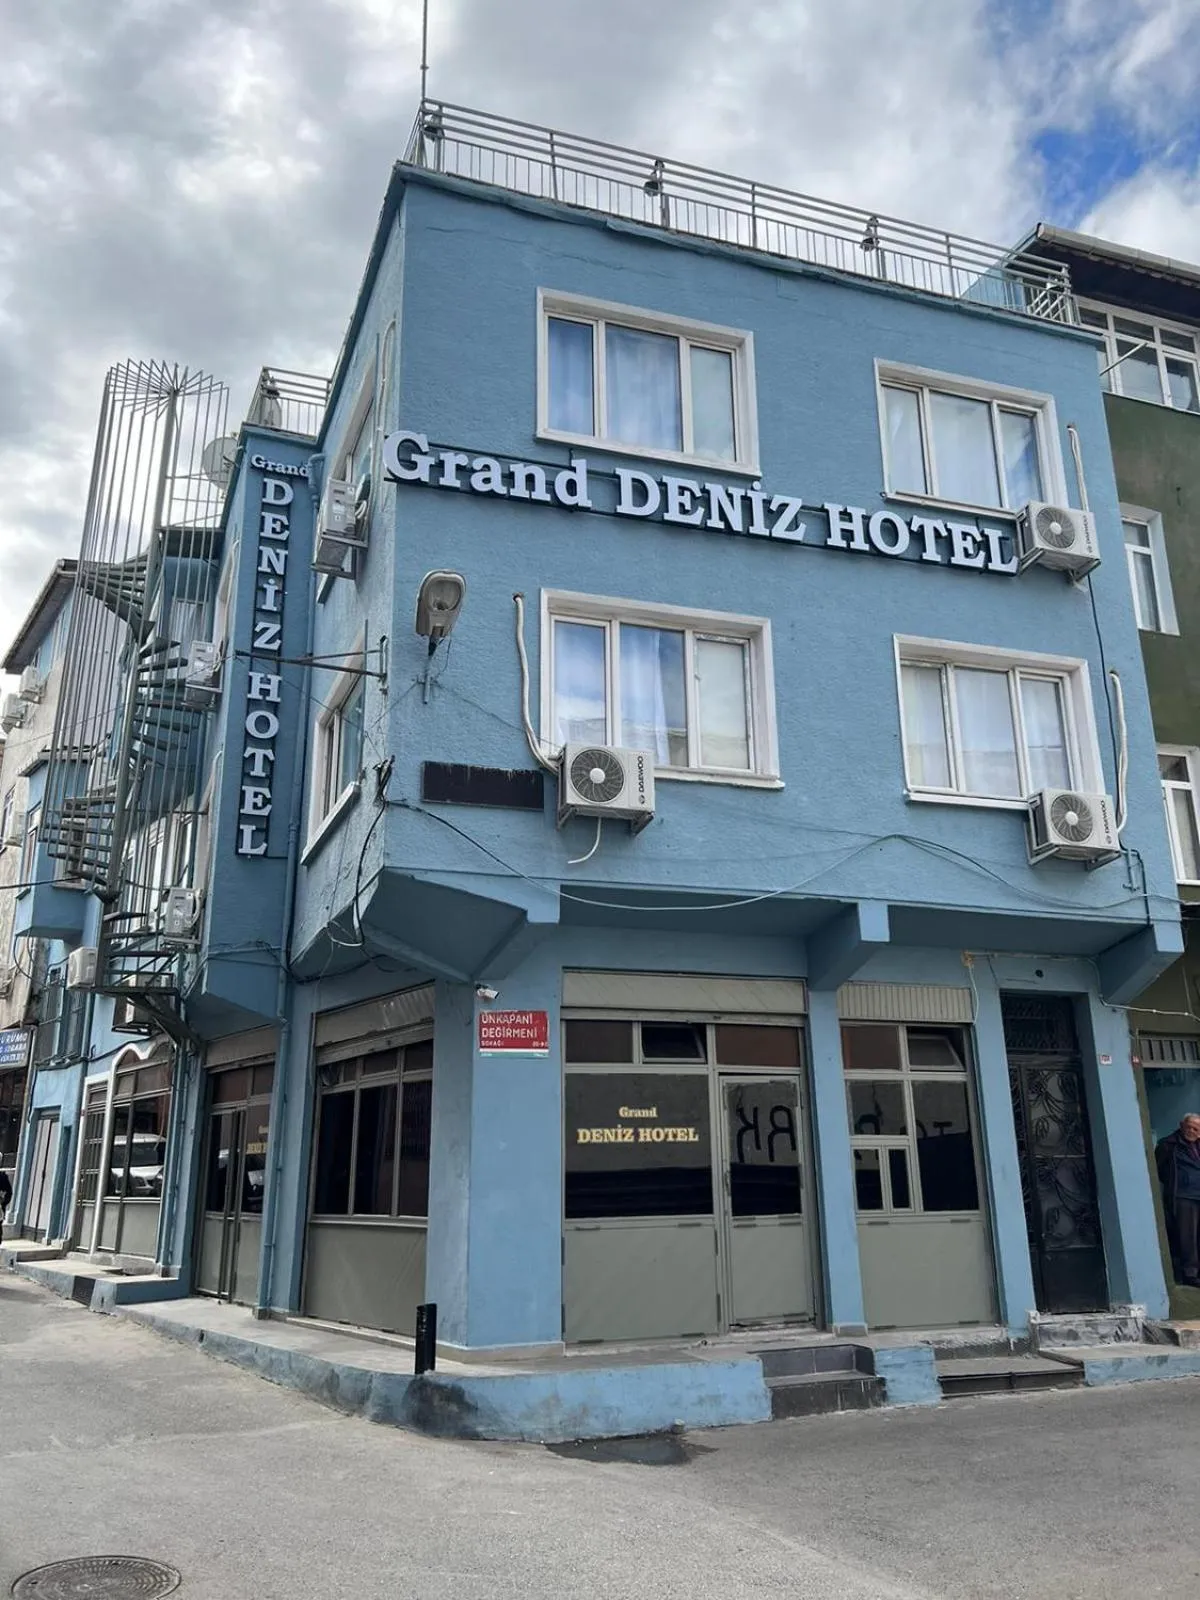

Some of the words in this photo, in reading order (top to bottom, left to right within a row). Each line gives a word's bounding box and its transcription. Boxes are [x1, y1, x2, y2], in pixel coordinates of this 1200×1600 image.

[254, 478, 294, 651] DENİZ
[382, 430, 592, 507] Grand
[615, 467, 807, 541] DENİZ
[824, 502, 1018, 573] HOTEL
[238, 671, 283, 855] HOTEL
[576, 1124, 635, 1143] DENİZ
[637, 1127, 699, 1142] HOTEL
[619, 1106, 659, 1118] Grand
